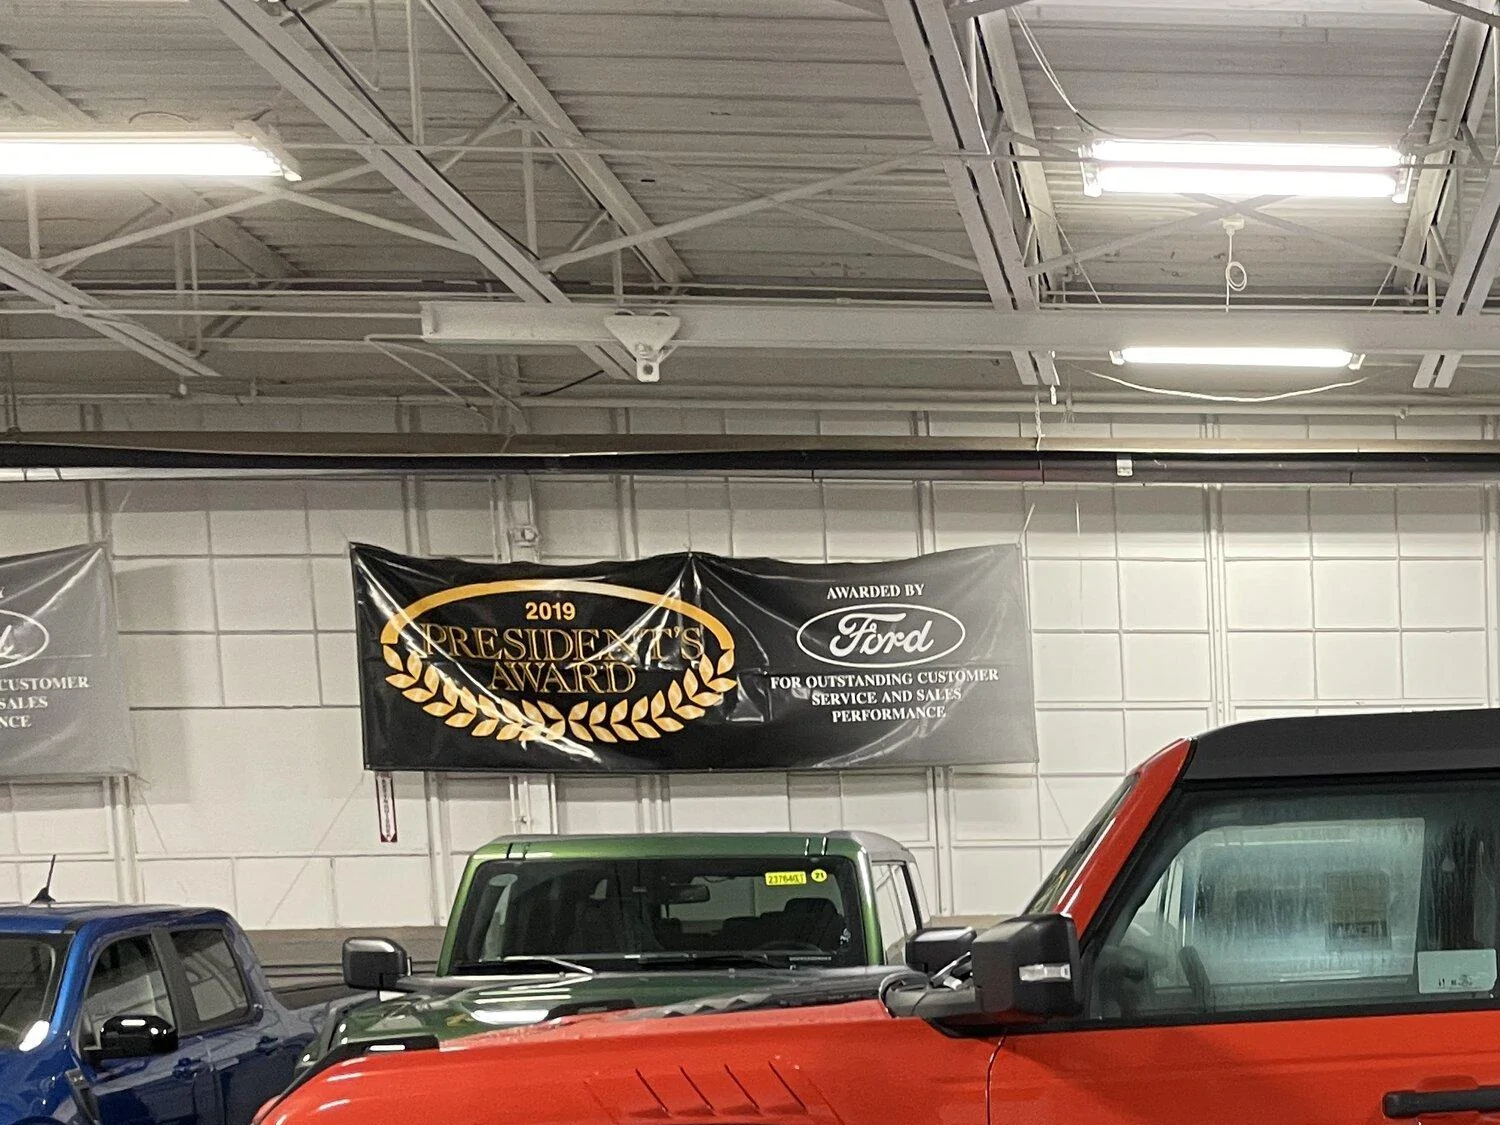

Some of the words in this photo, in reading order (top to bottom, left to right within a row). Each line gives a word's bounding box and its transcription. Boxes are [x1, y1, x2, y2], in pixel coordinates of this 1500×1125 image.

[826, 583, 901, 601] AWARDED
[904, 583, 926, 599] BY
[525, 601, 577, 622] 2019
[419, 623, 705, 661] PRESIDENT'S
[828, 611, 935, 658] Ford
[486, 660, 638, 694] AWARD
[770, 675, 801, 690] FOR
[805, 672, 913, 690] OUTSTANDING
[917, 668, 1000, 686] CUSTOMER
[811, 691, 878, 707] SERVICE
[881, 689, 913, 704] AND
[916, 687, 963, 703] SALES
[831, 705, 947, 724] PERFORMANCE
